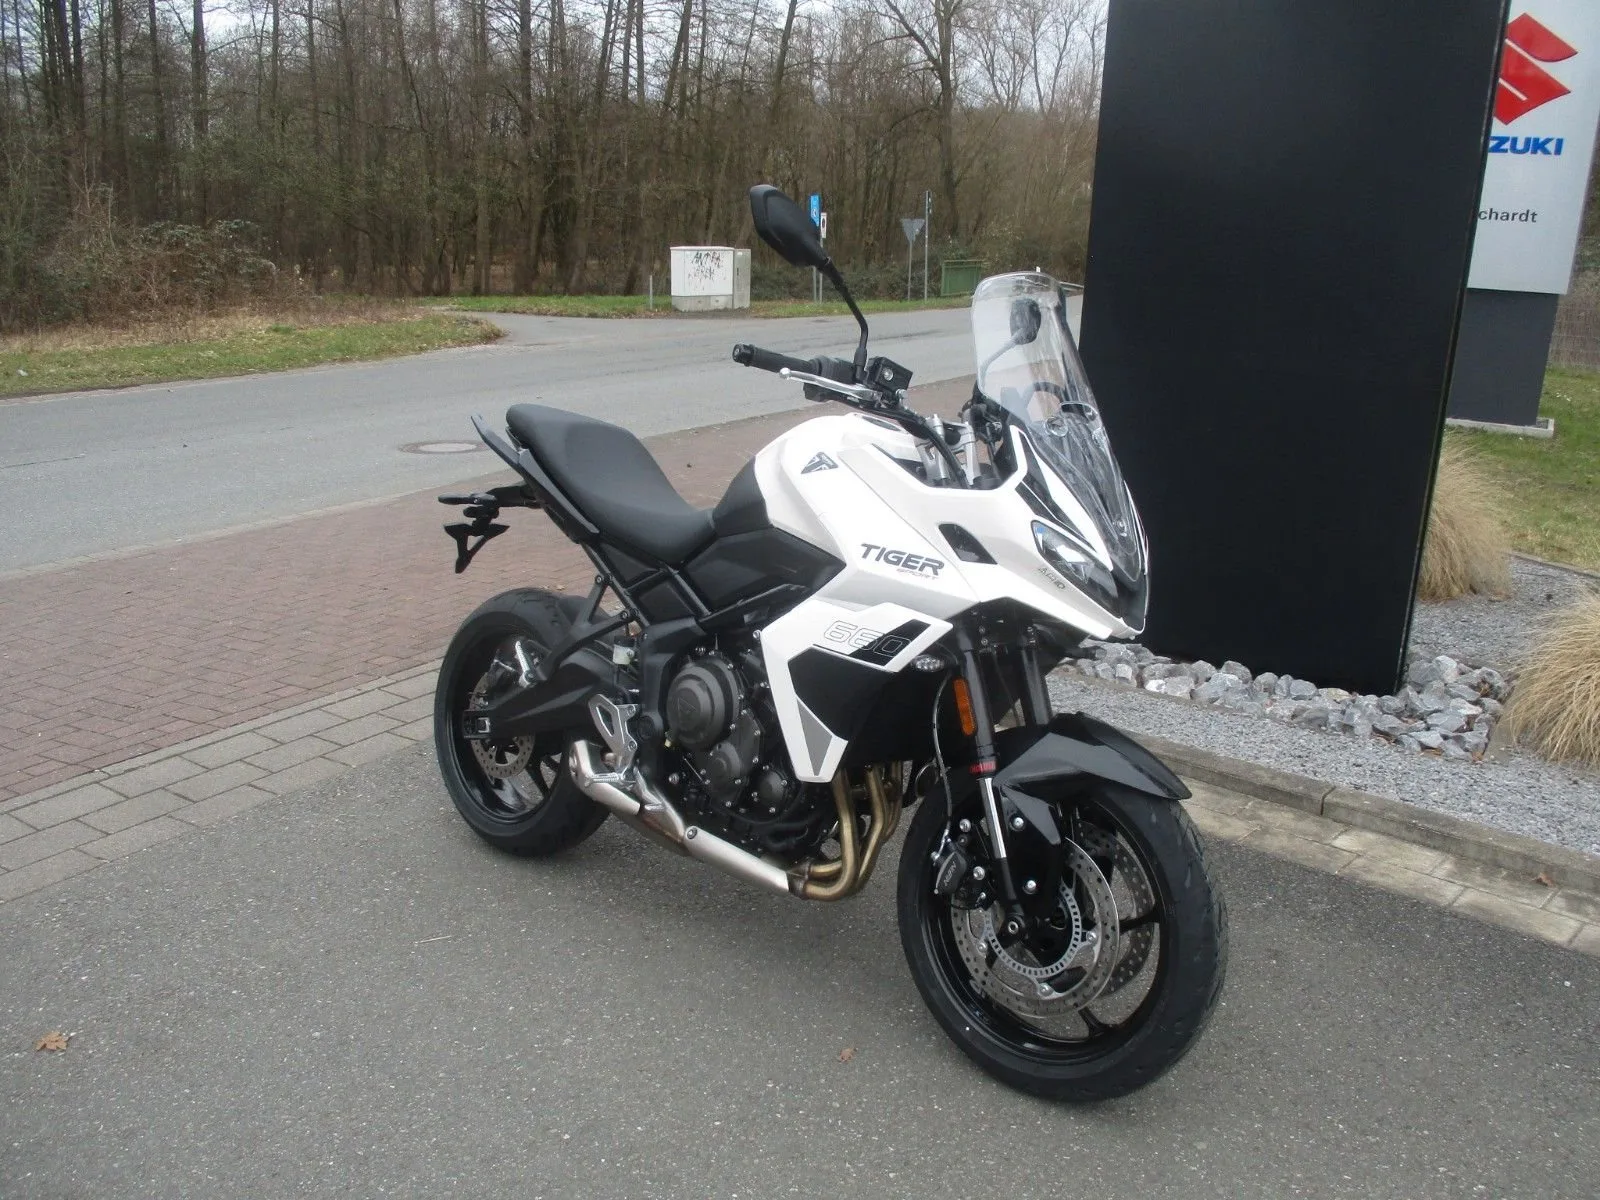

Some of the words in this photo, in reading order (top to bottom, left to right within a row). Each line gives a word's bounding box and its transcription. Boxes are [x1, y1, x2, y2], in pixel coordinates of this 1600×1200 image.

[1488, 135, 1564, 156] ZUKI
[1478, 207, 1538, 223] chardt
[861, 543, 945, 576] TIGER
[823, 619, 912, 659] 660
